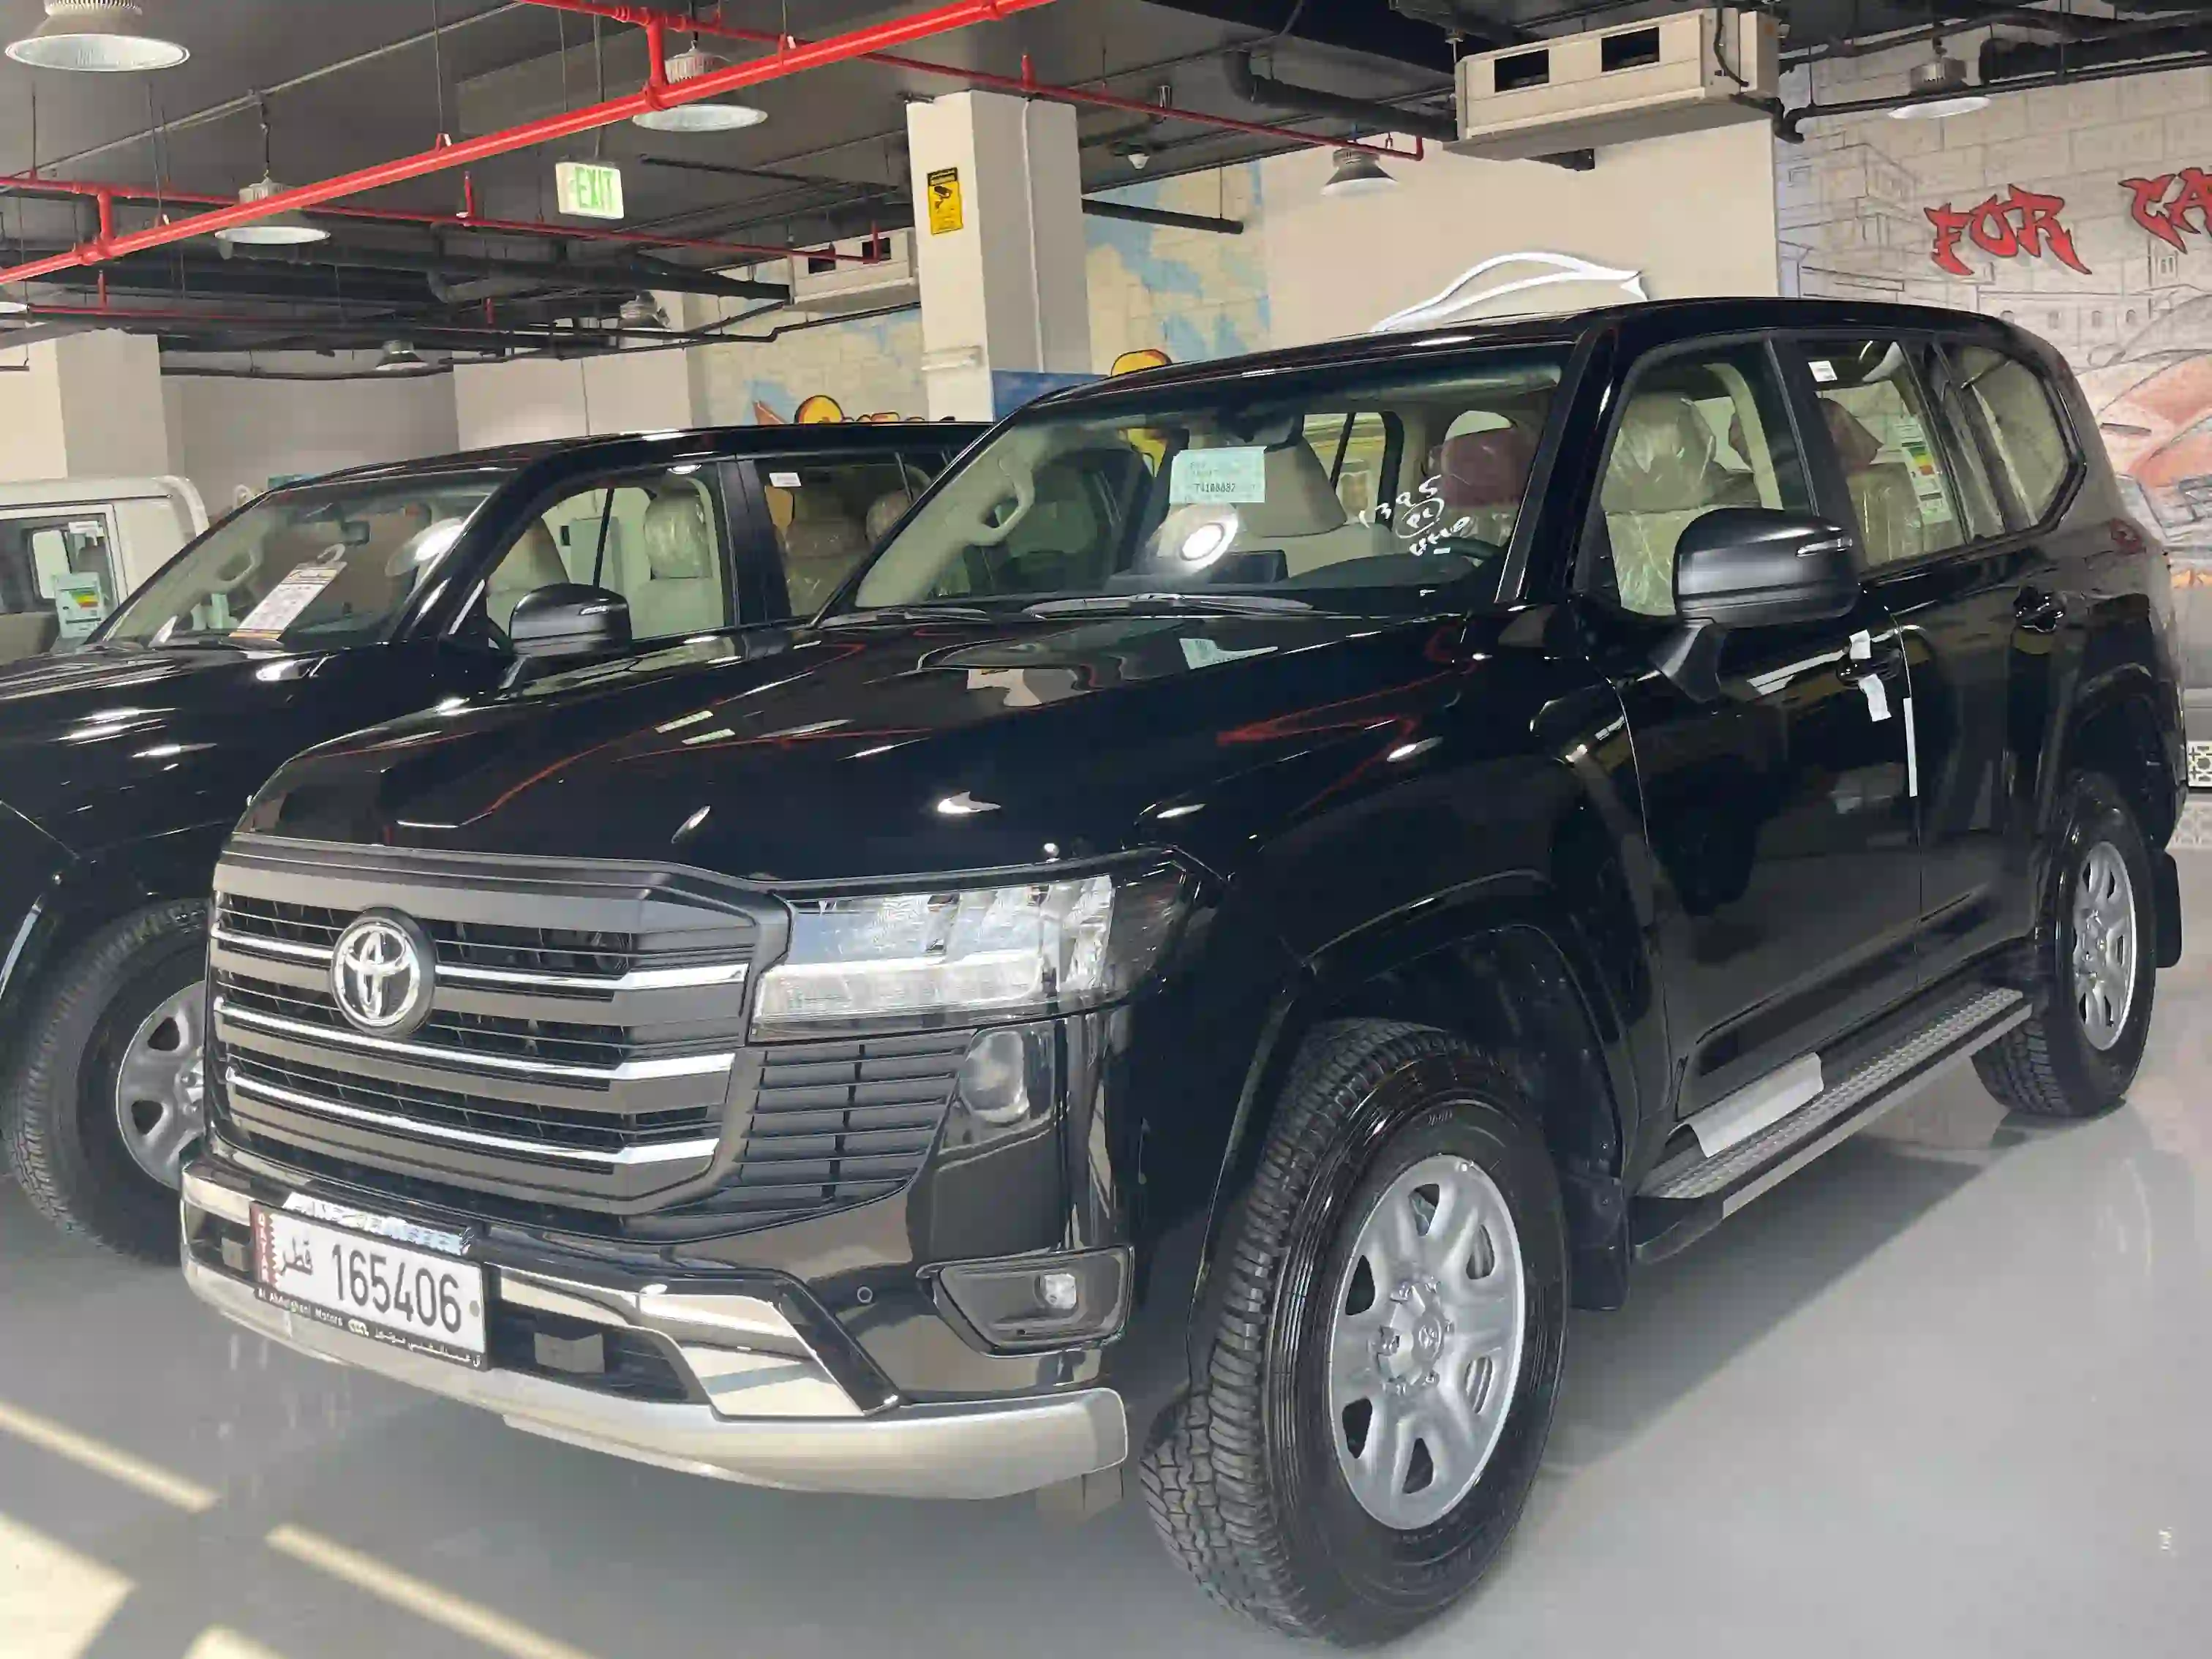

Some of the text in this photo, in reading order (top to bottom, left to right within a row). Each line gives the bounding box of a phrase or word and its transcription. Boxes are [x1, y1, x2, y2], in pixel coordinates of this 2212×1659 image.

[574, 166, 613, 211] EXIT
[1924, 167, 2212, 276] FOR CA
[281, 1236, 313, 1276] قطر
[332, 1243, 462, 1334] 165406
